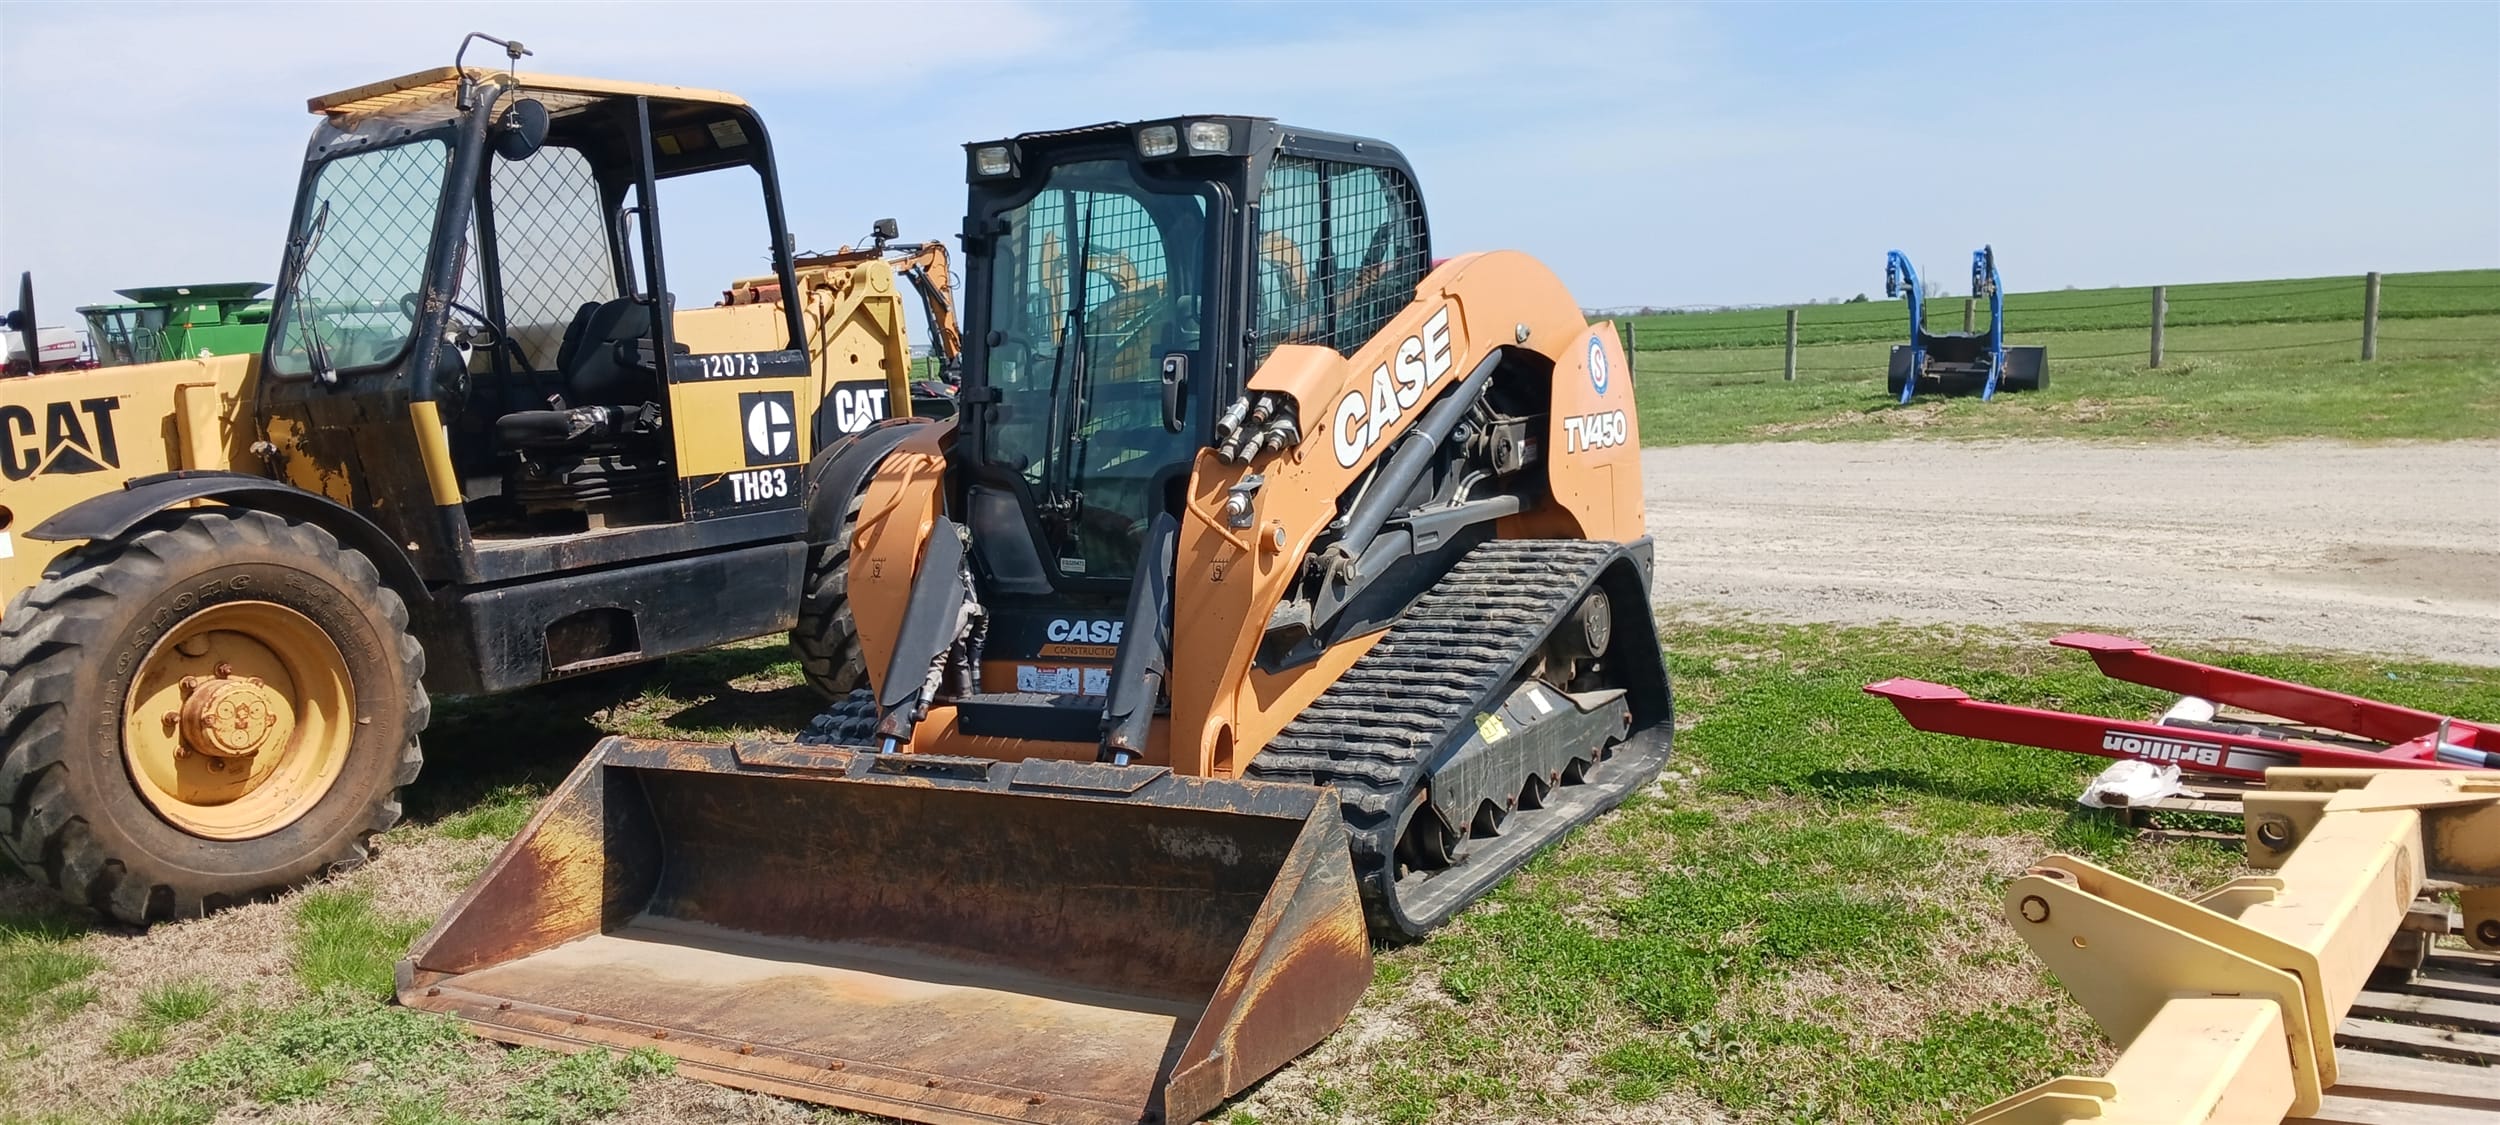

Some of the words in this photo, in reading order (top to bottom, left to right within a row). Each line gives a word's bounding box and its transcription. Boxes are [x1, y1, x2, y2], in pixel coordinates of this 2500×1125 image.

[700, 353, 760, 379] 12073
[1333, 304, 1453, 469] CASE
[835, 388, 888, 434] CAT
[0, 396, 121, 482] CAT
[1564, 409, 1629, 454] TV450
[729, 469, 788, 503] TH83
[1047, 619, 1124, 643] CASE
[1054, 645, 1116, 657] CONSTRUCTIO
[2102, 734, 2222, 767] Brillion
